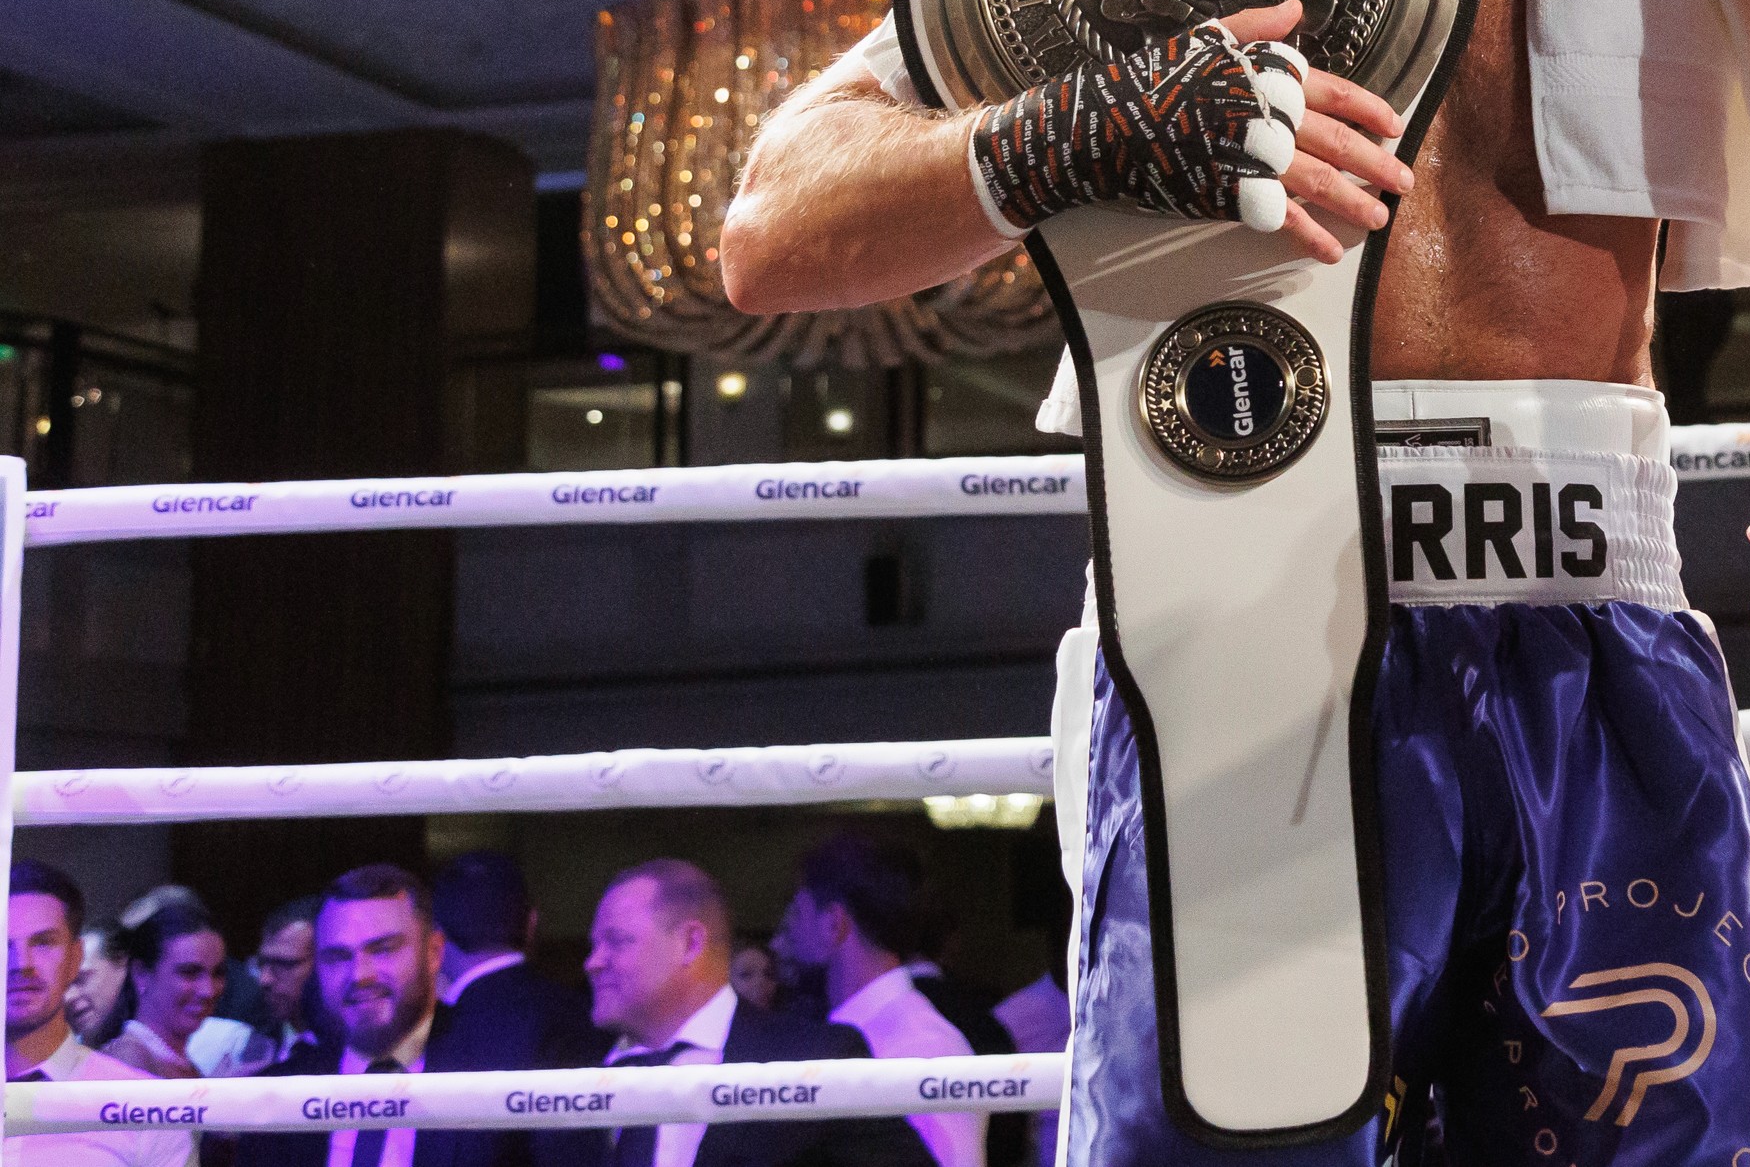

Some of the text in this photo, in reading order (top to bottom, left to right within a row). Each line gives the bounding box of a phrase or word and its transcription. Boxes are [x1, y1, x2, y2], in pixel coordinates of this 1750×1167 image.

[1181, 67, 1197, 83] gym
[1102, 89, 1117, 105] gym
[1127, 101, 1142, 120] tape
[1047, 121, 1056, 143] gym
[1089, 111, 1101, 159] gym tape
[1139, 120, 1156, 141] gym
[1023, 119, 1036, 166] gym tape
[1220, 136, 1241, 151] gym
[1001, 139, 1020, 186] gym tape
[1228, 346, 1254, 436] Glencar
[552, 483, 659, 506] Glencar
[755, 478, 861, 501] Glencar
[961, 474, 1070, 496] Glencar
[152, 492, 259, 514] Glencar
[350, 487, 458, 510] Glencar
[1390, 482, 1608, 581] RRIS
[711, 1082, 820, 1107] Glencar
[919, 1076, 1030, 1101] Glencar
[100, 1100, 208, 1125] Glencar
[302, 1096, 410, 1121] Glencar
[506, 1089, 615, 1115] Glencar
